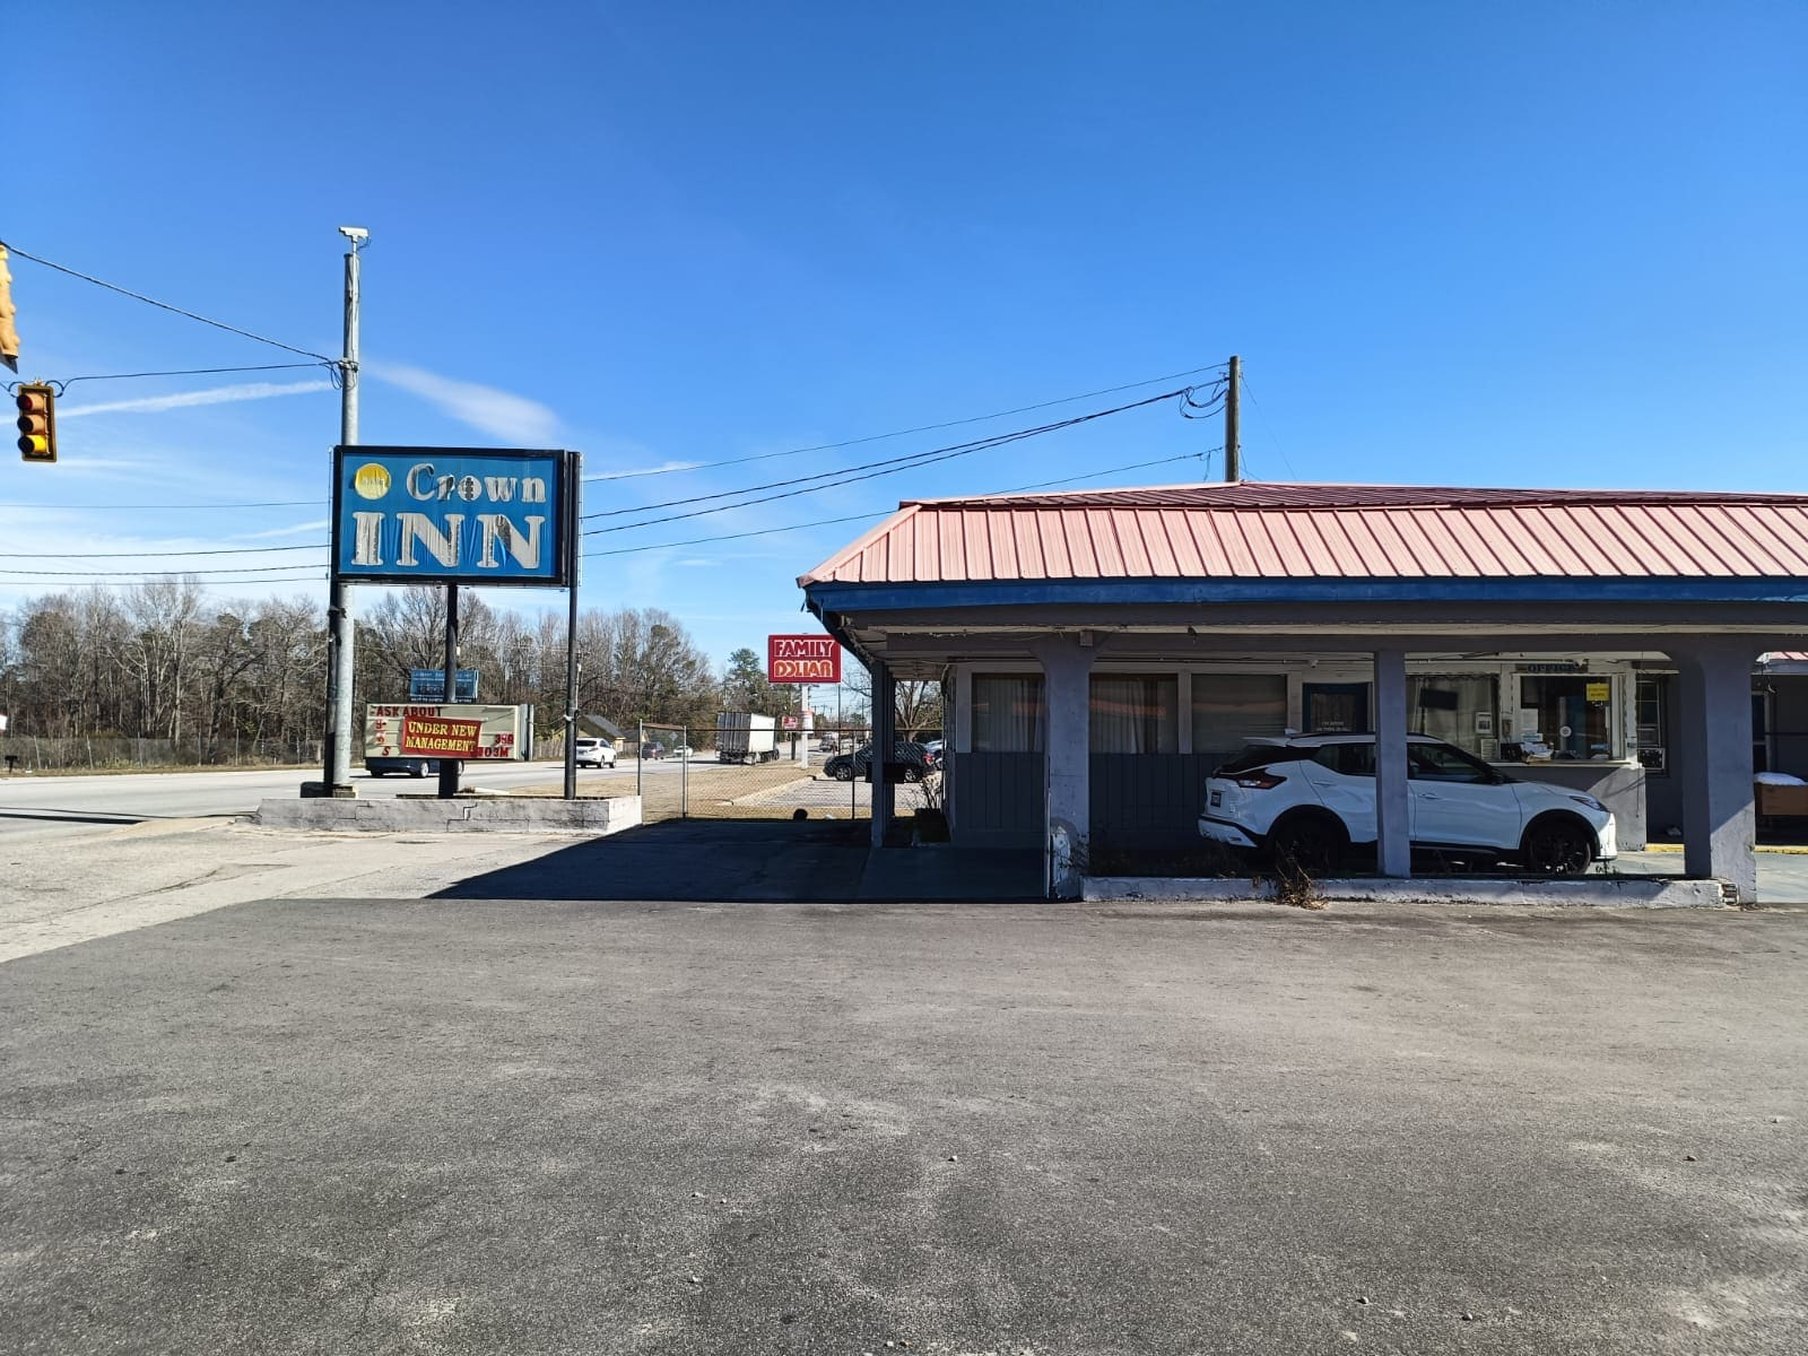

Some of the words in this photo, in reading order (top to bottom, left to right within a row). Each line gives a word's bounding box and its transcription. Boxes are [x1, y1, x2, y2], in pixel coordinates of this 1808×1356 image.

[407, 463, 546, 503] Crown
[351, 512, 545, 569] INN
[774, 639, 835, 657] FAMILY
[774, 660, 833, 678] DOLLAR
[376, 706, 399, 716] ASK
[403, 707, 441, 717] ABOUT
[408, 721, 448, 735] UNDER
[452, 724, 477, 737] NEW
[405, 737, 476, 752] MANAGEMENT
